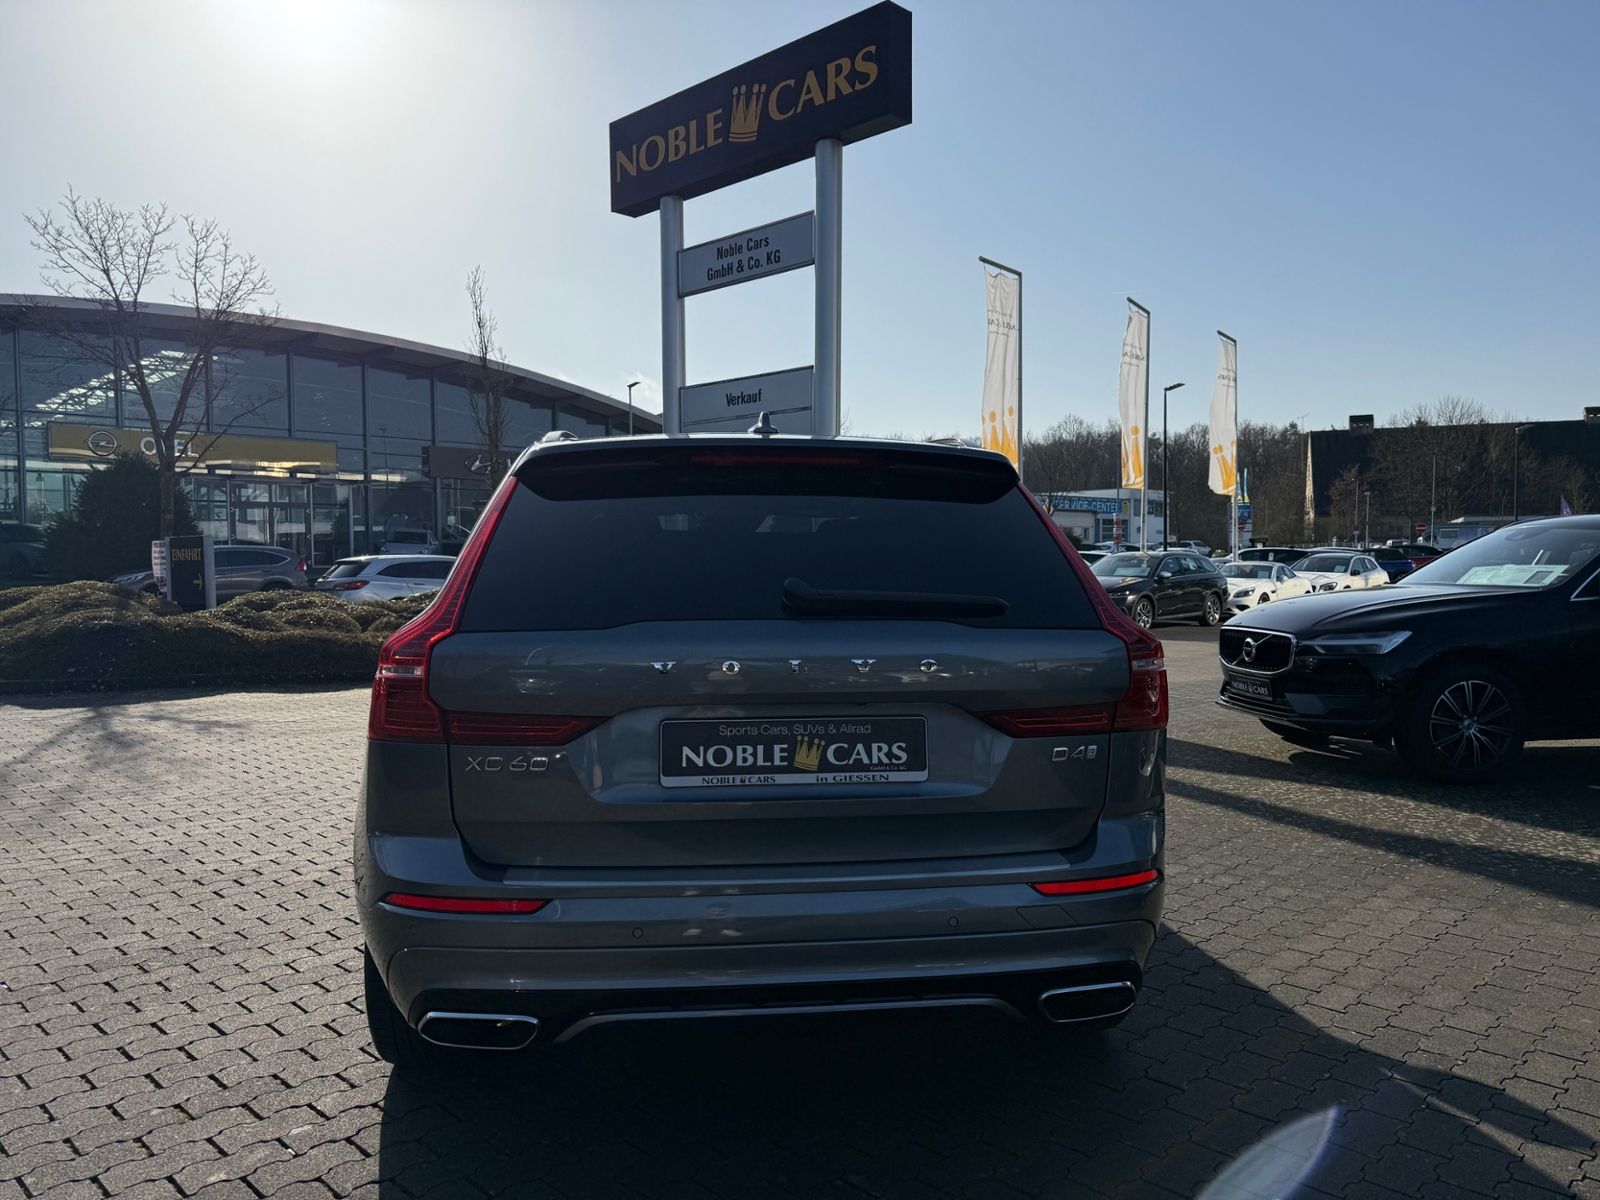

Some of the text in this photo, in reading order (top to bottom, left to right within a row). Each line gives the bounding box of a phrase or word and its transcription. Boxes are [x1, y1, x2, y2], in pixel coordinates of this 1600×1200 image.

[615, 45, 879, 183] NOBLE CARS
[716, 236, 769, 260] Noble Cars
[707, 249, 781, 281] GmbH & Co. KG
[725, 389, 762, 407] Verkauf
[140, 437, 199, 458] OEL
[650, 659, 938, 675] VOLVO
[719, 723, 872, 737] Sports Cars, SUVs & Allrad
[681, 742, 908, 767] NOBLE CARS
[702, 774, 889, 785] NOBLE CARS in GIESSEN
